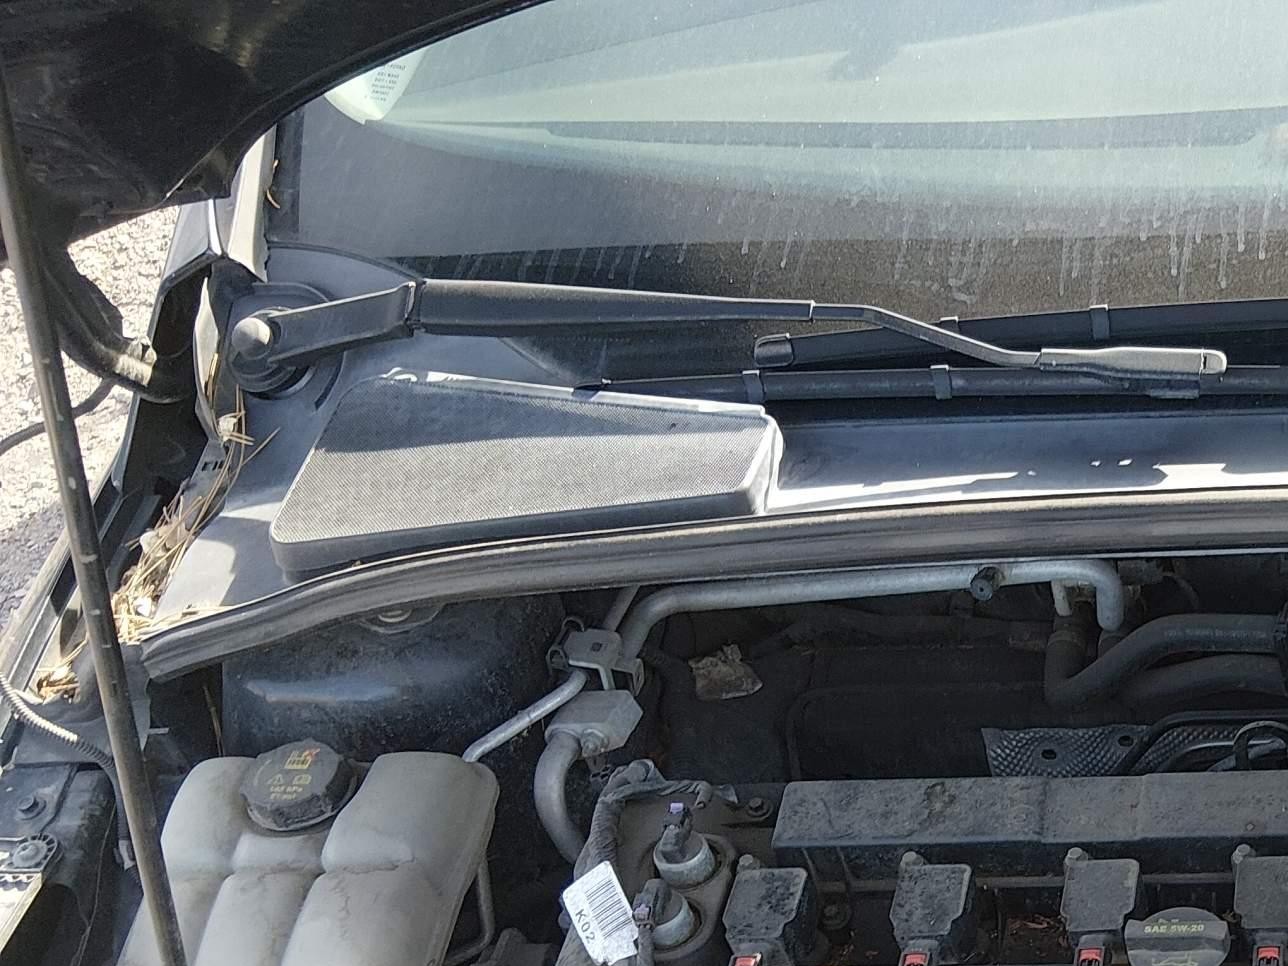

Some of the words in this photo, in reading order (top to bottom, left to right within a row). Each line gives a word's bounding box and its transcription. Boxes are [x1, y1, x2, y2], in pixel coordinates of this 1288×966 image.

[575, 908, 596, 945] K02
[1144, 925, 1167, 933] SAE
[1171, 923, 1205, 933] 5W-20
